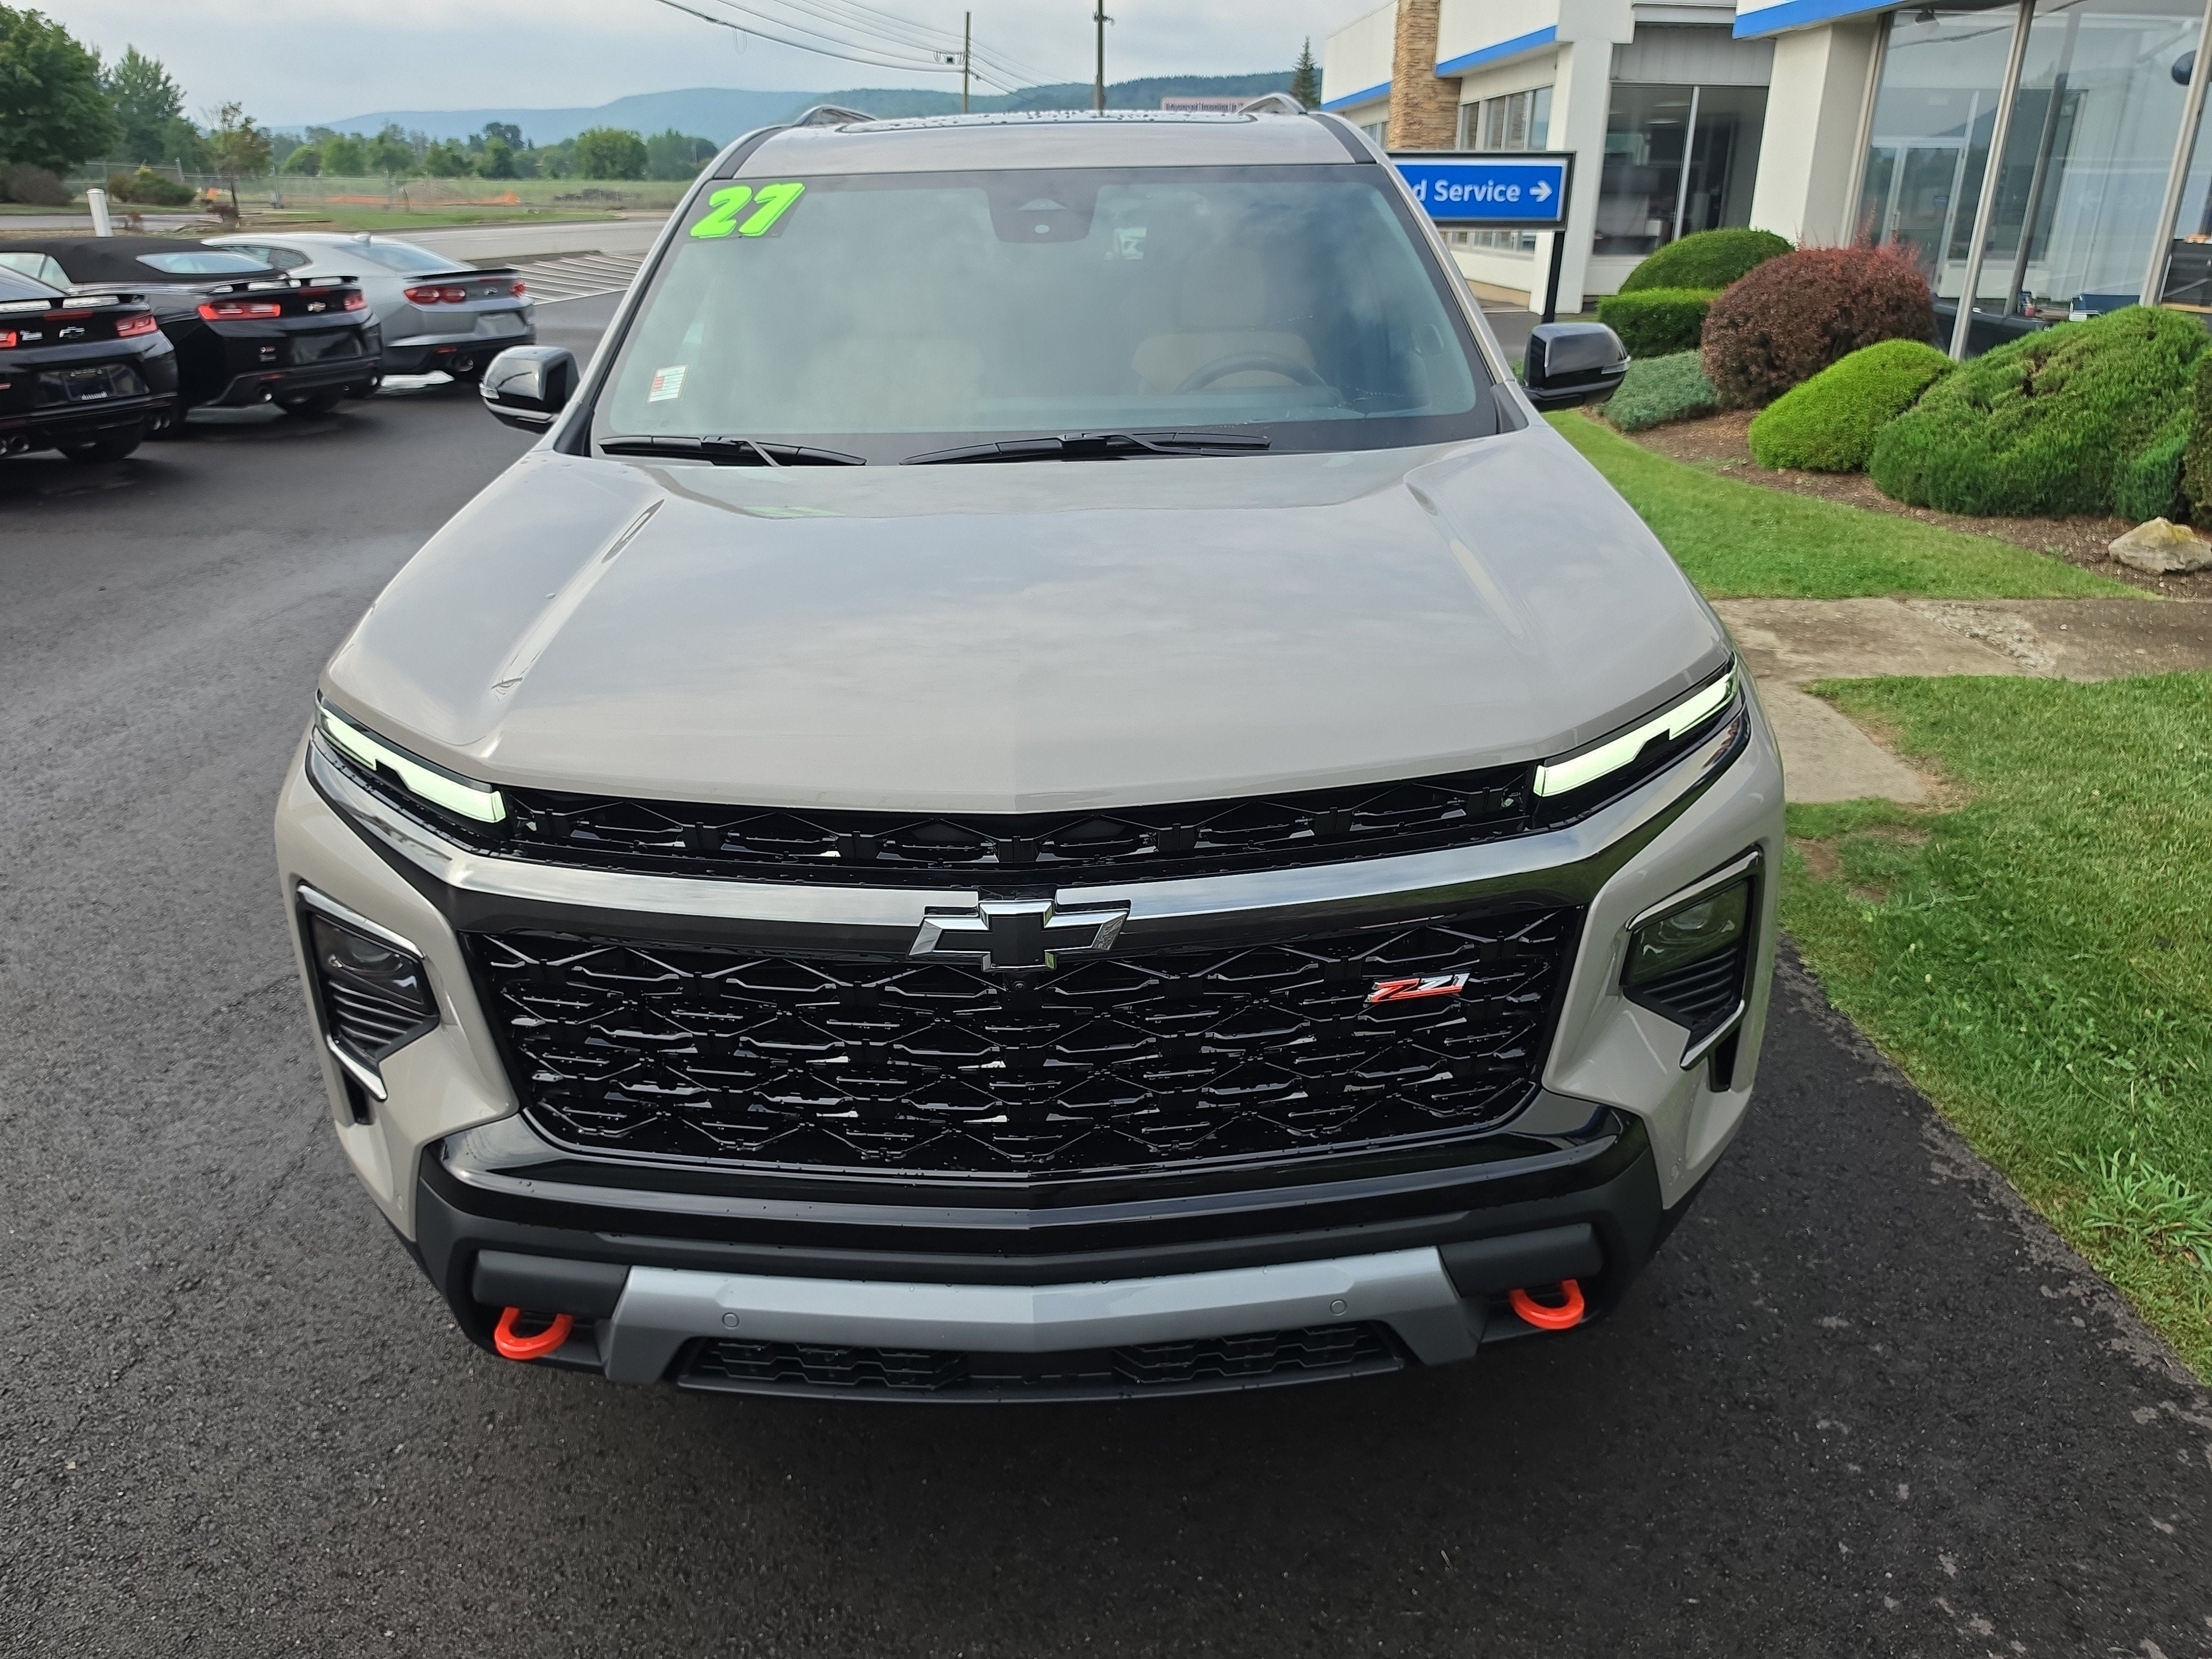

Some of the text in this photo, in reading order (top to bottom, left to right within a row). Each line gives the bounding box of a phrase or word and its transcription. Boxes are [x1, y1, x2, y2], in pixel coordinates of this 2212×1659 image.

[1434, 179, 1521, 202] Service
[690, 182, 805, 239] 27
[1364, 973, 1470, 1002] Z71
